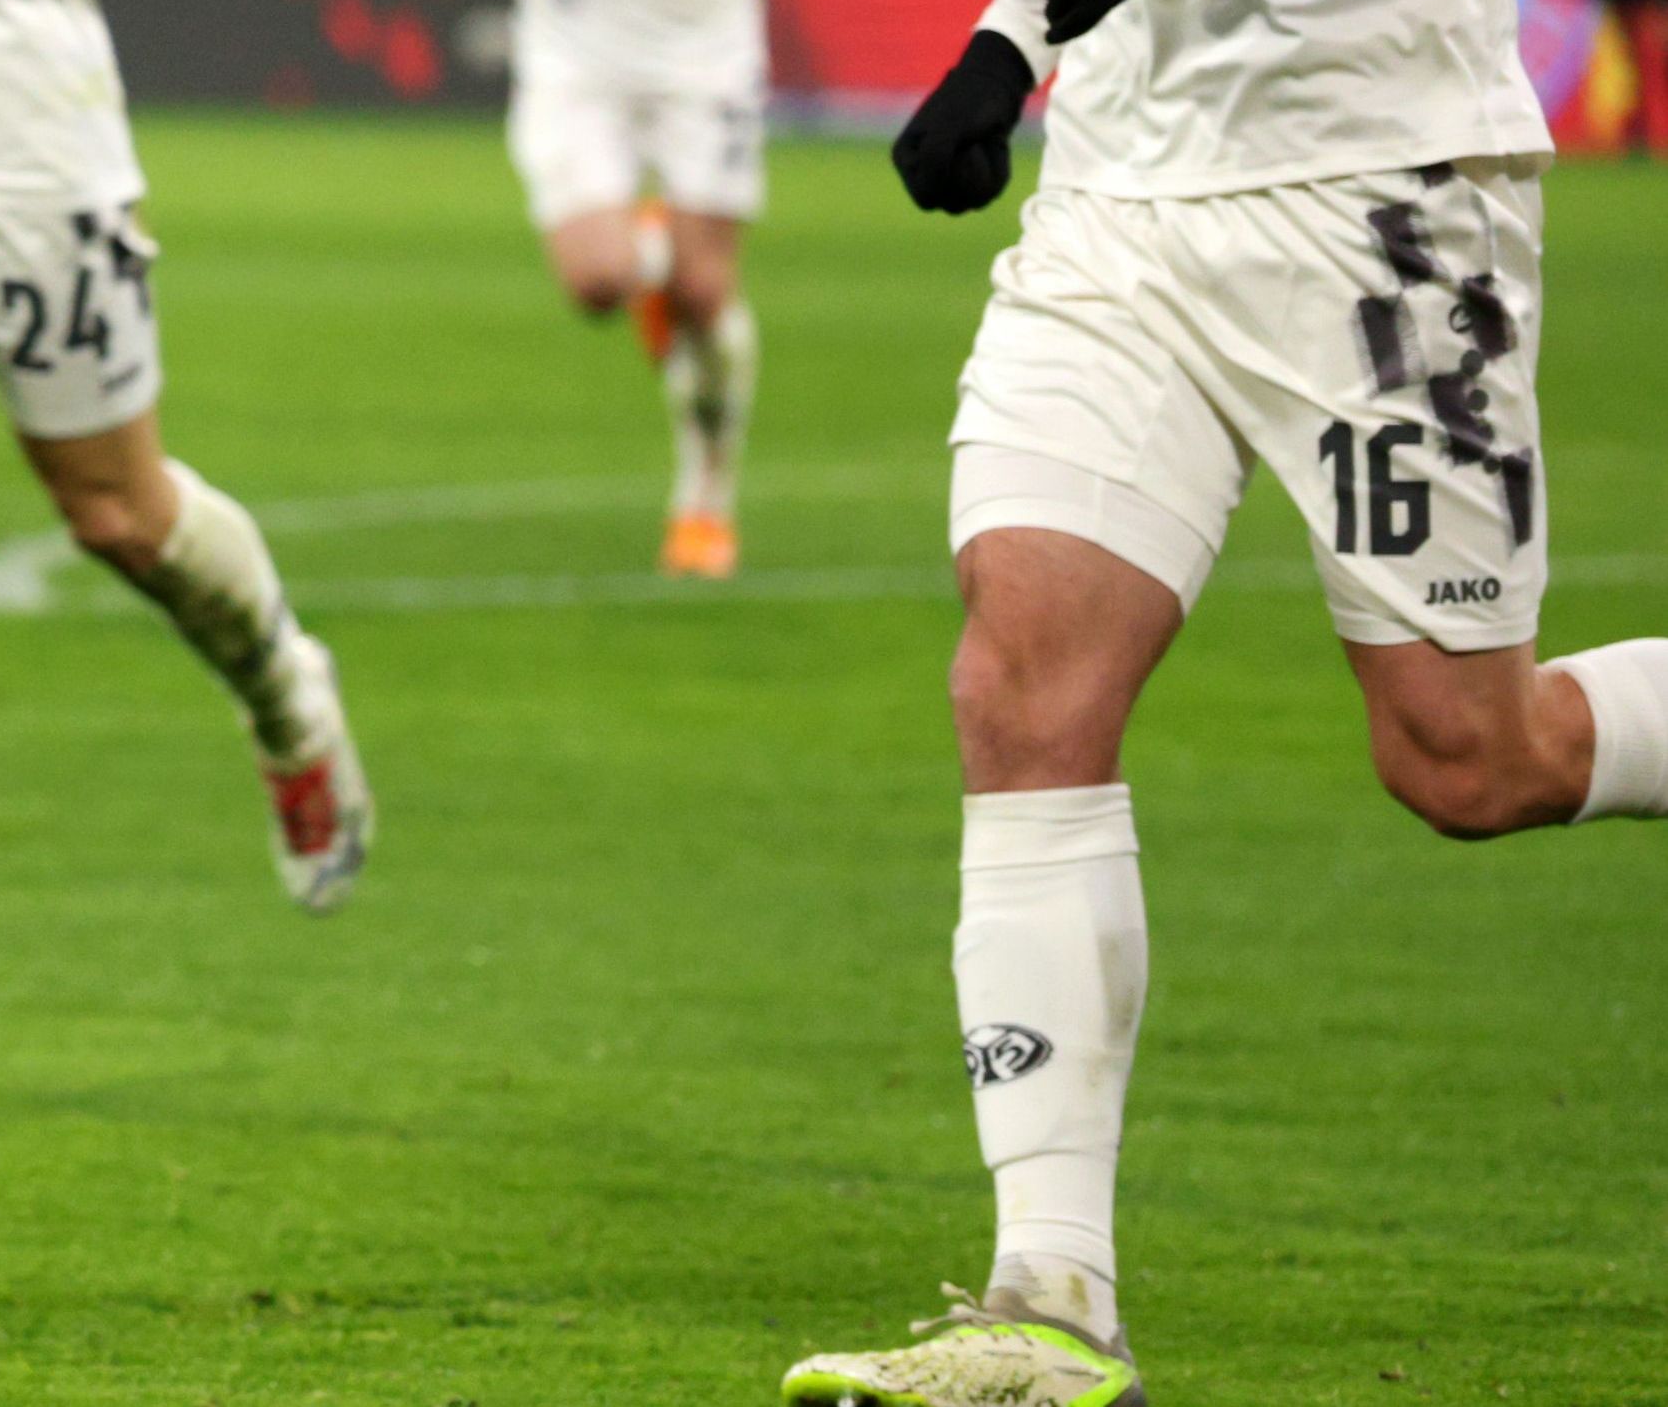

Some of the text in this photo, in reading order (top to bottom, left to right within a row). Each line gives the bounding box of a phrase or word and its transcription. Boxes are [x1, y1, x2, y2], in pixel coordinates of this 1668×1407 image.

[1, 266, 111, 374] 24
[1319, 421, 1432, 556] 16
[1424, 577, 1502, 606] JAKO
